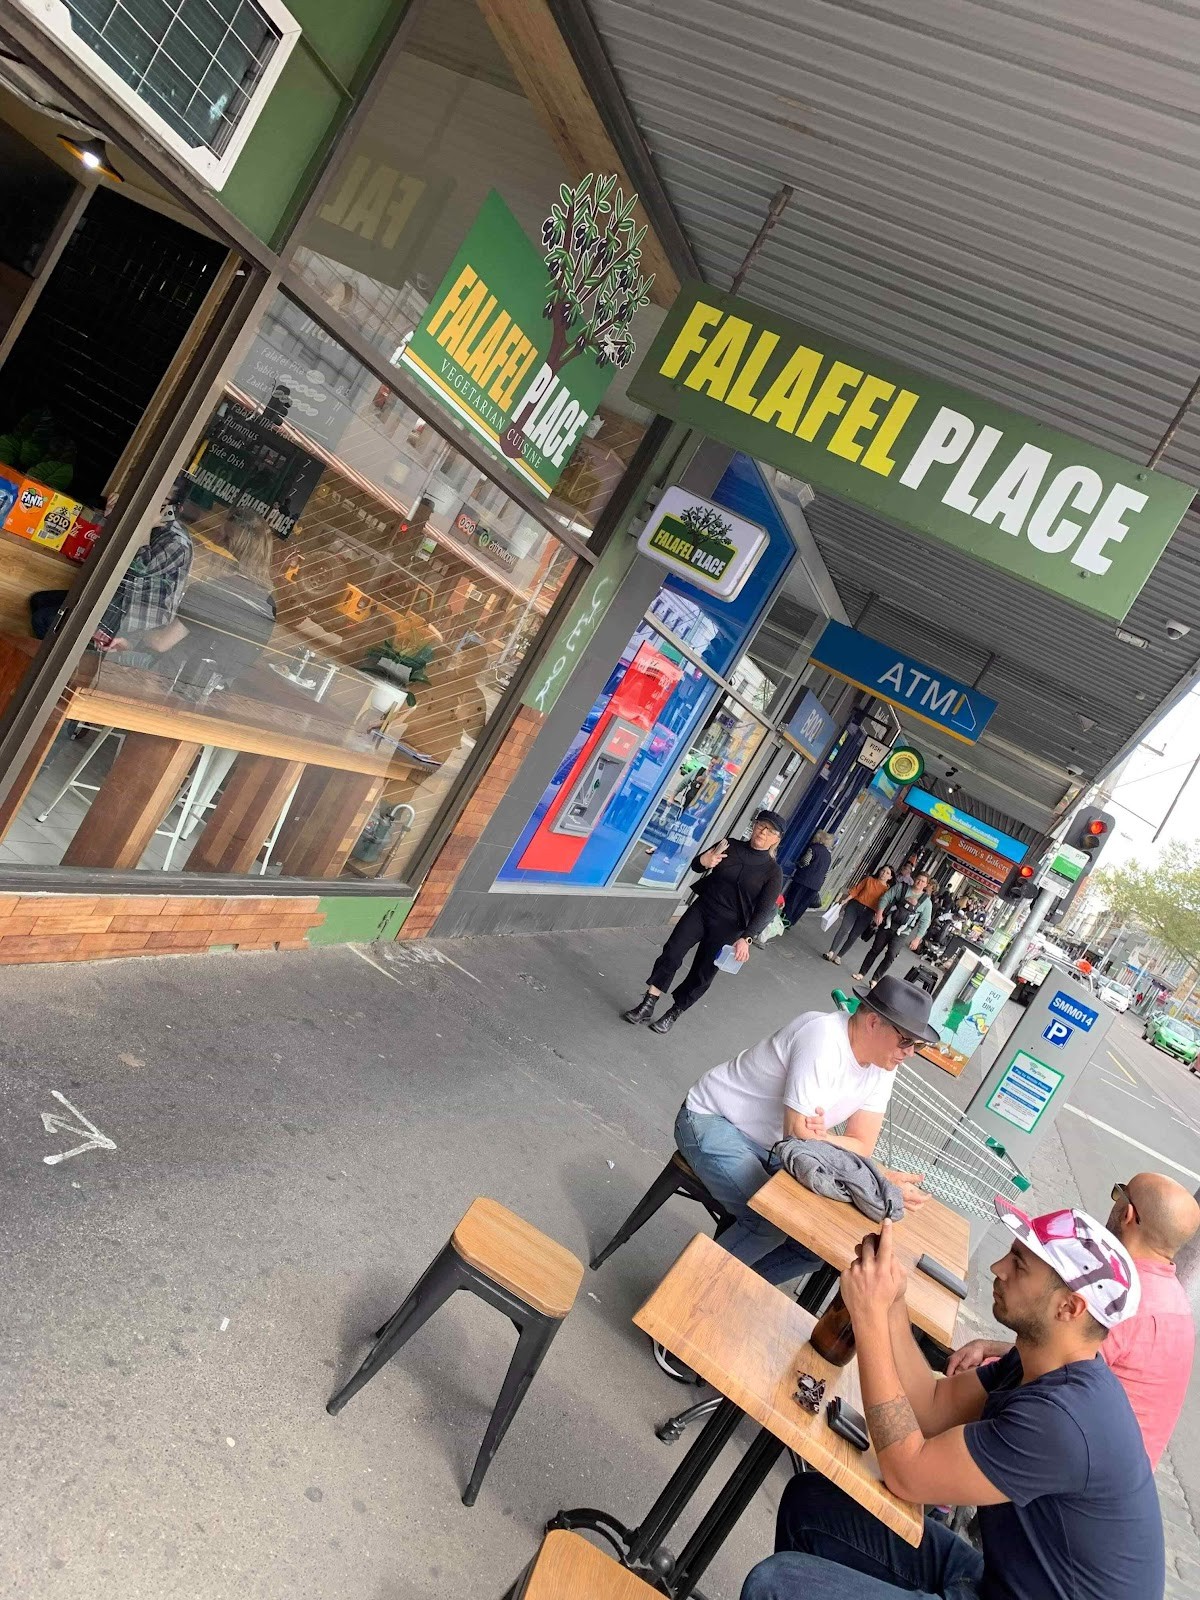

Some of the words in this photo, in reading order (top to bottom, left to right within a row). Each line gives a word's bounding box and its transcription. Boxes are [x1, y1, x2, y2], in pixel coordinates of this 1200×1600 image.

[426, 263, 538, 413] FALAFEL
[511, 361, 589, 468] PLACE
[230, 402, 259, 422] Falafel
[440, 358, 505, 430] VEGETARIAN
[506, 428, 543, 469] CUISINE
[223, 415, 260, 441] Hummus
[303, 459, 312, 468] 7
[658, 300, 920, 478] FALAFEL
[898, 405, 1150, 577] PLACE
[209, 443, 227, 459] Side
[227, 451, 245, 470] Dish
[289, 488, 298, 497] 7
[296, 473, 305, 483] 7
[21, 491, 43, 507] FANTA
[214, 478, 240, 504] PLACE
[266, 507, 295, 535] PLACE
[48, 513, 69, 528] SOLO
[653, 528, 695, 561] FALAFEL
[690, 548, 727, 577] PLACE
[877, 662, 955, 718] ATM
[859, 754, 877, 768] CHIPS
[869, 743, 882, 753] FISH
[958, 840, 984, 859] Sunny's
[985, 853, 1010, 873] Bakery
[985, 996, 993, 1004] IN
[989, 990, 1001, 1001] PUT
[1052, 997, 1094, 1027] SMM014
[1046, 1021, 1068, 1041] P
